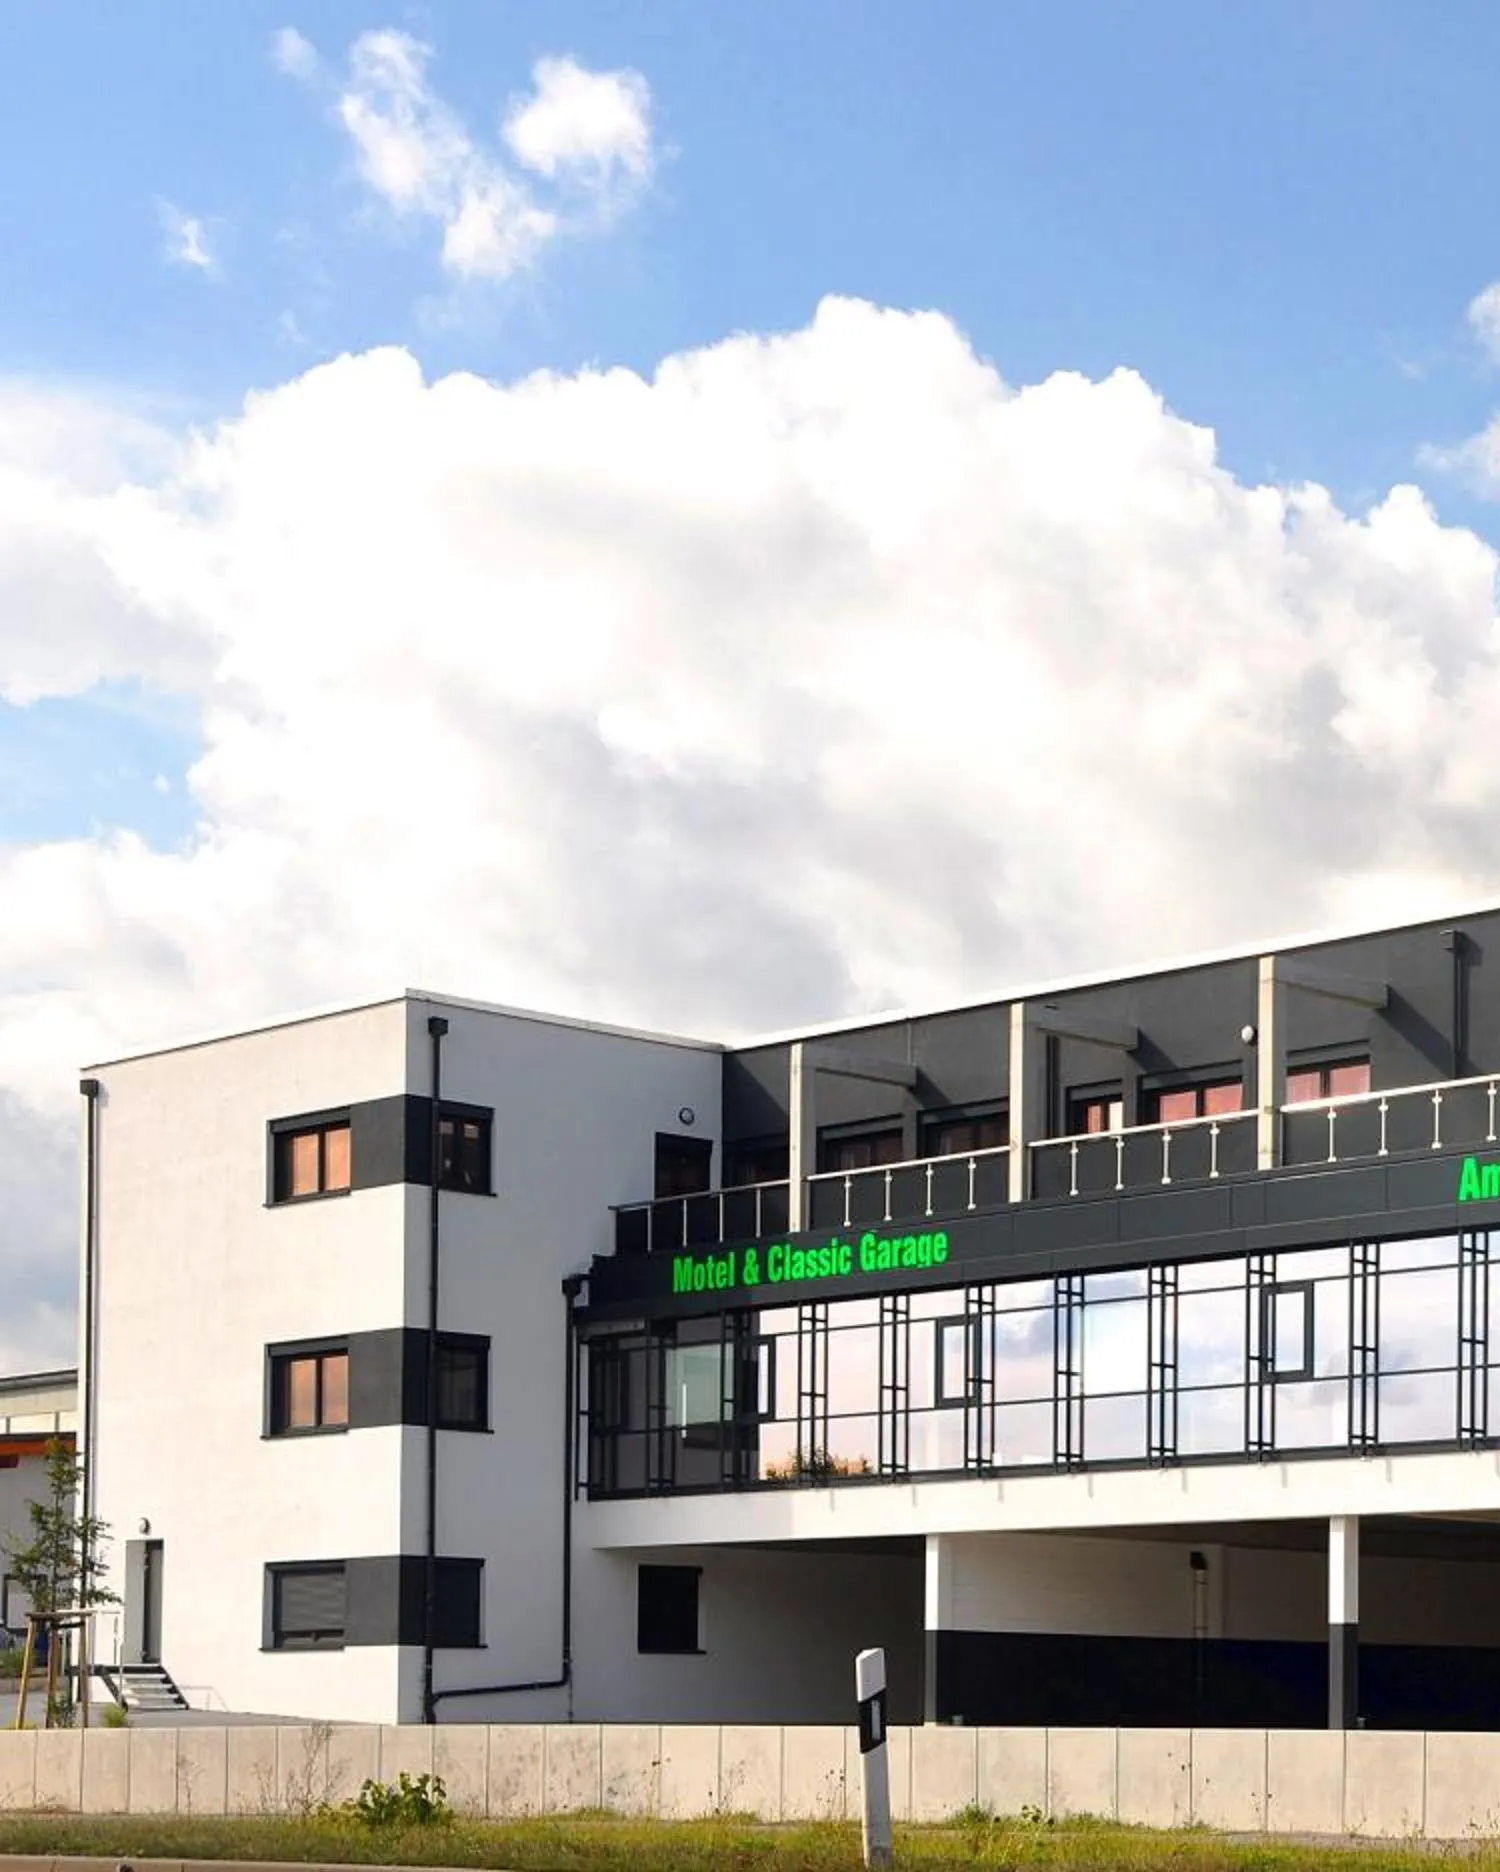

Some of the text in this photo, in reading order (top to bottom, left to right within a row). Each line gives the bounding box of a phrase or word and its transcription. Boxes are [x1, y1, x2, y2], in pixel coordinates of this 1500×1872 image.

[672, 1230, 949, 1292] Motel & Classic Garage
